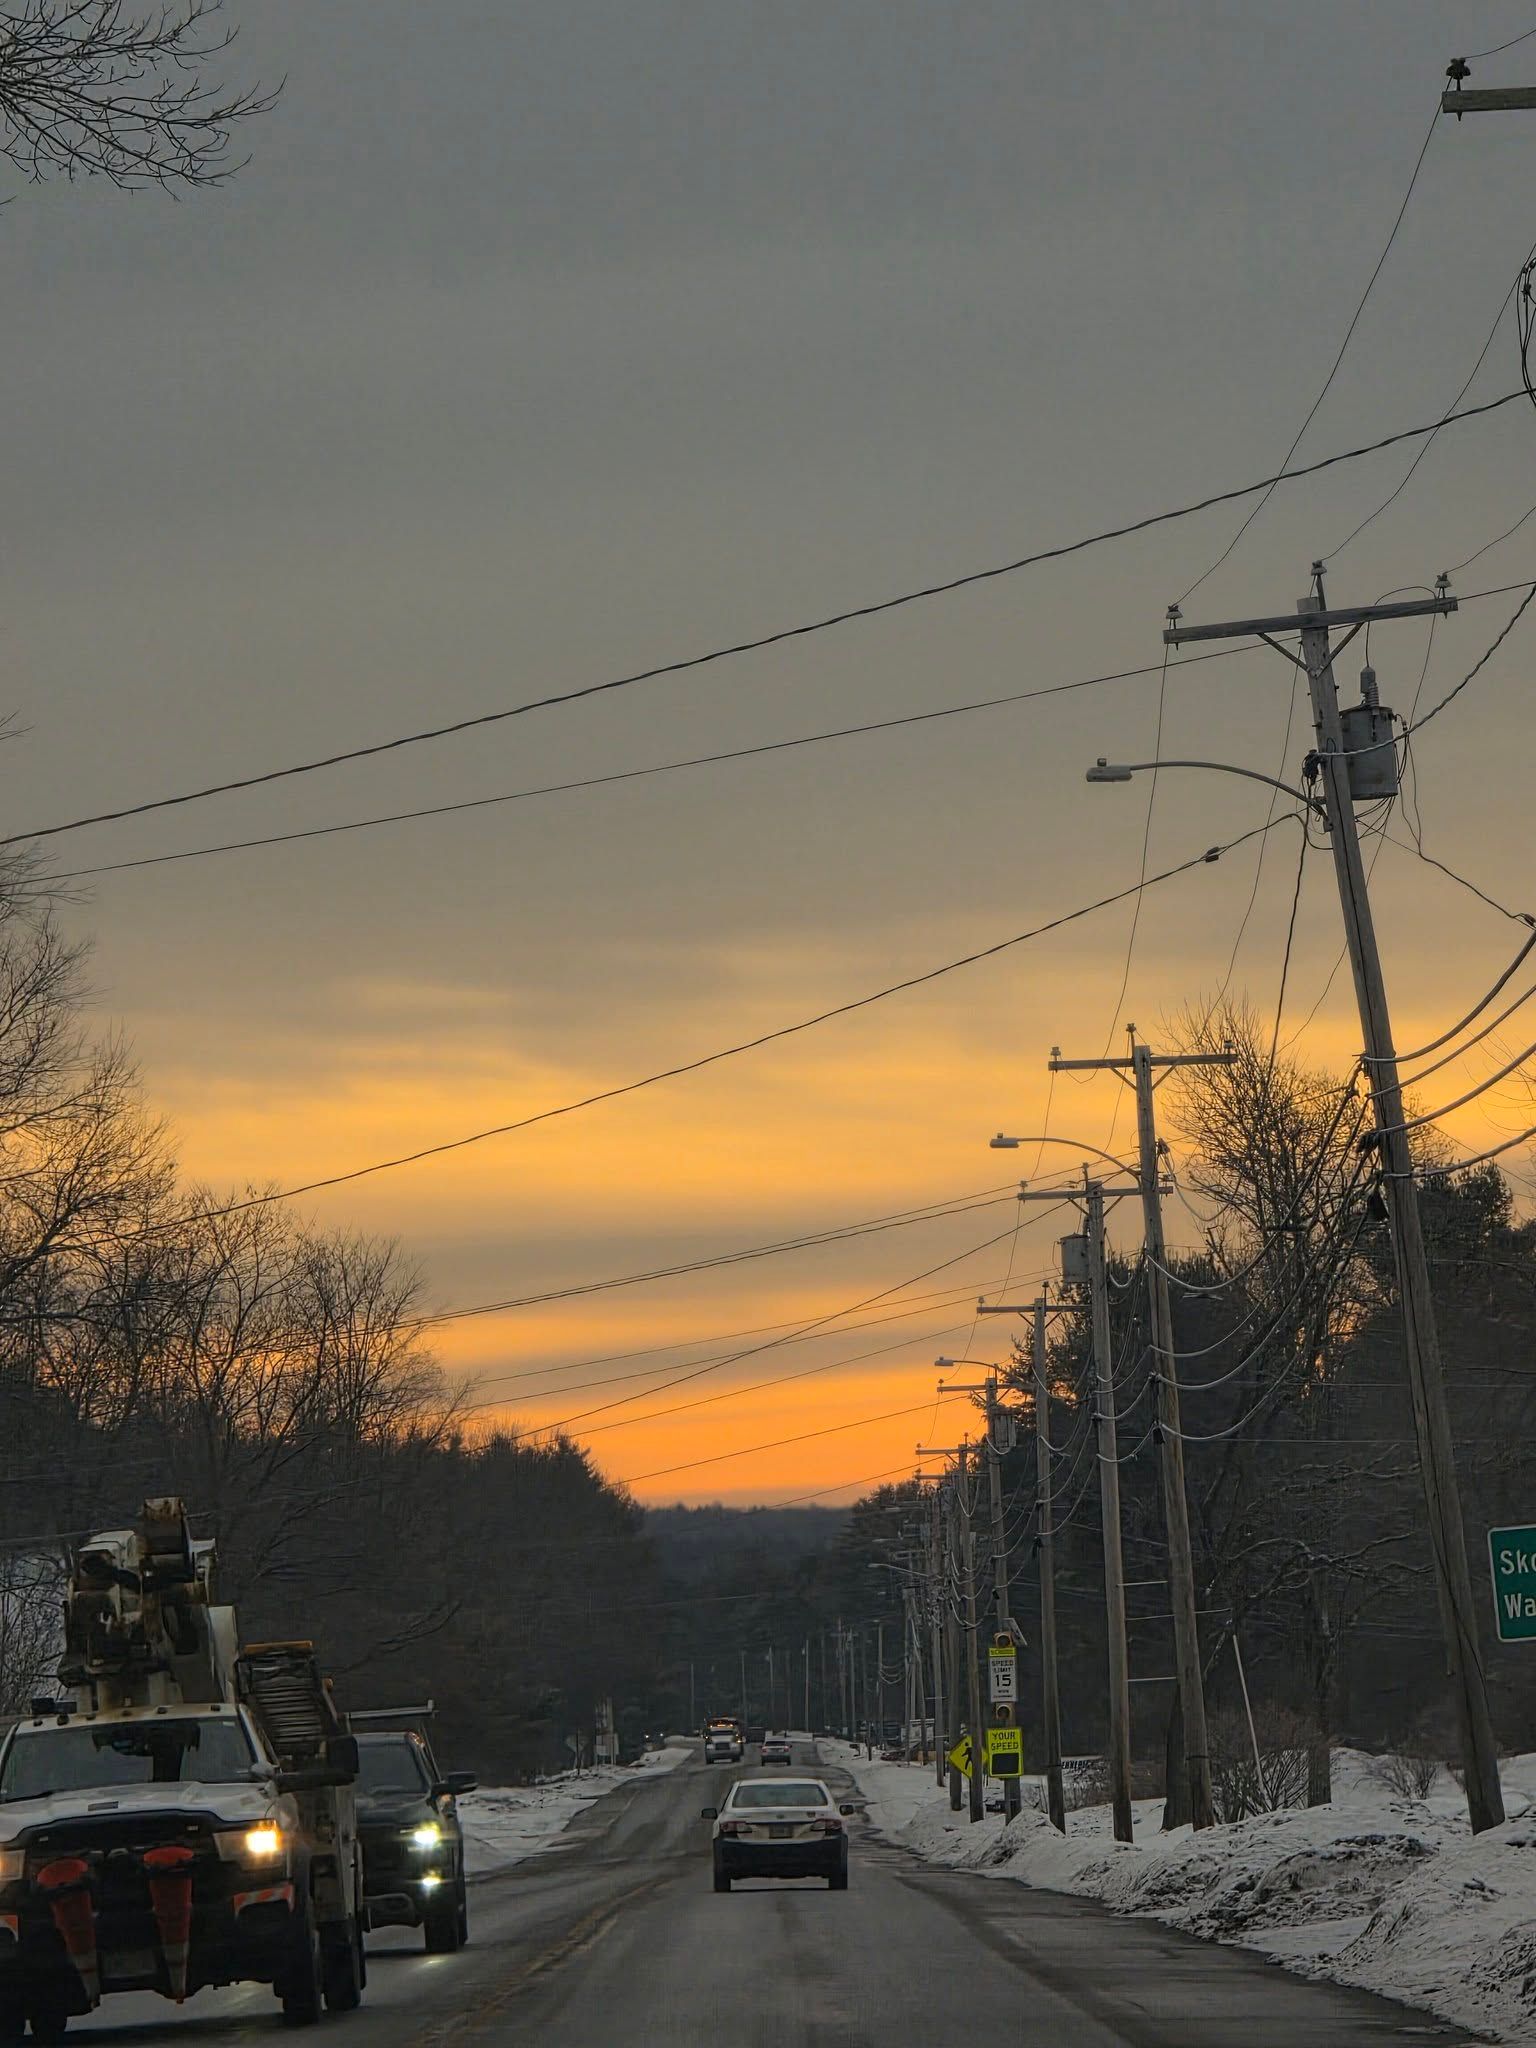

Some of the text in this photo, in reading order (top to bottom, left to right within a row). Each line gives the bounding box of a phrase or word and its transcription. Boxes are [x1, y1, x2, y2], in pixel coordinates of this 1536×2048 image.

[995, 1674, 1012, 1687] 15
[991, 1731, 1016, 1741] YOUR
[991, 1741, 1019, 1751] SPEED
